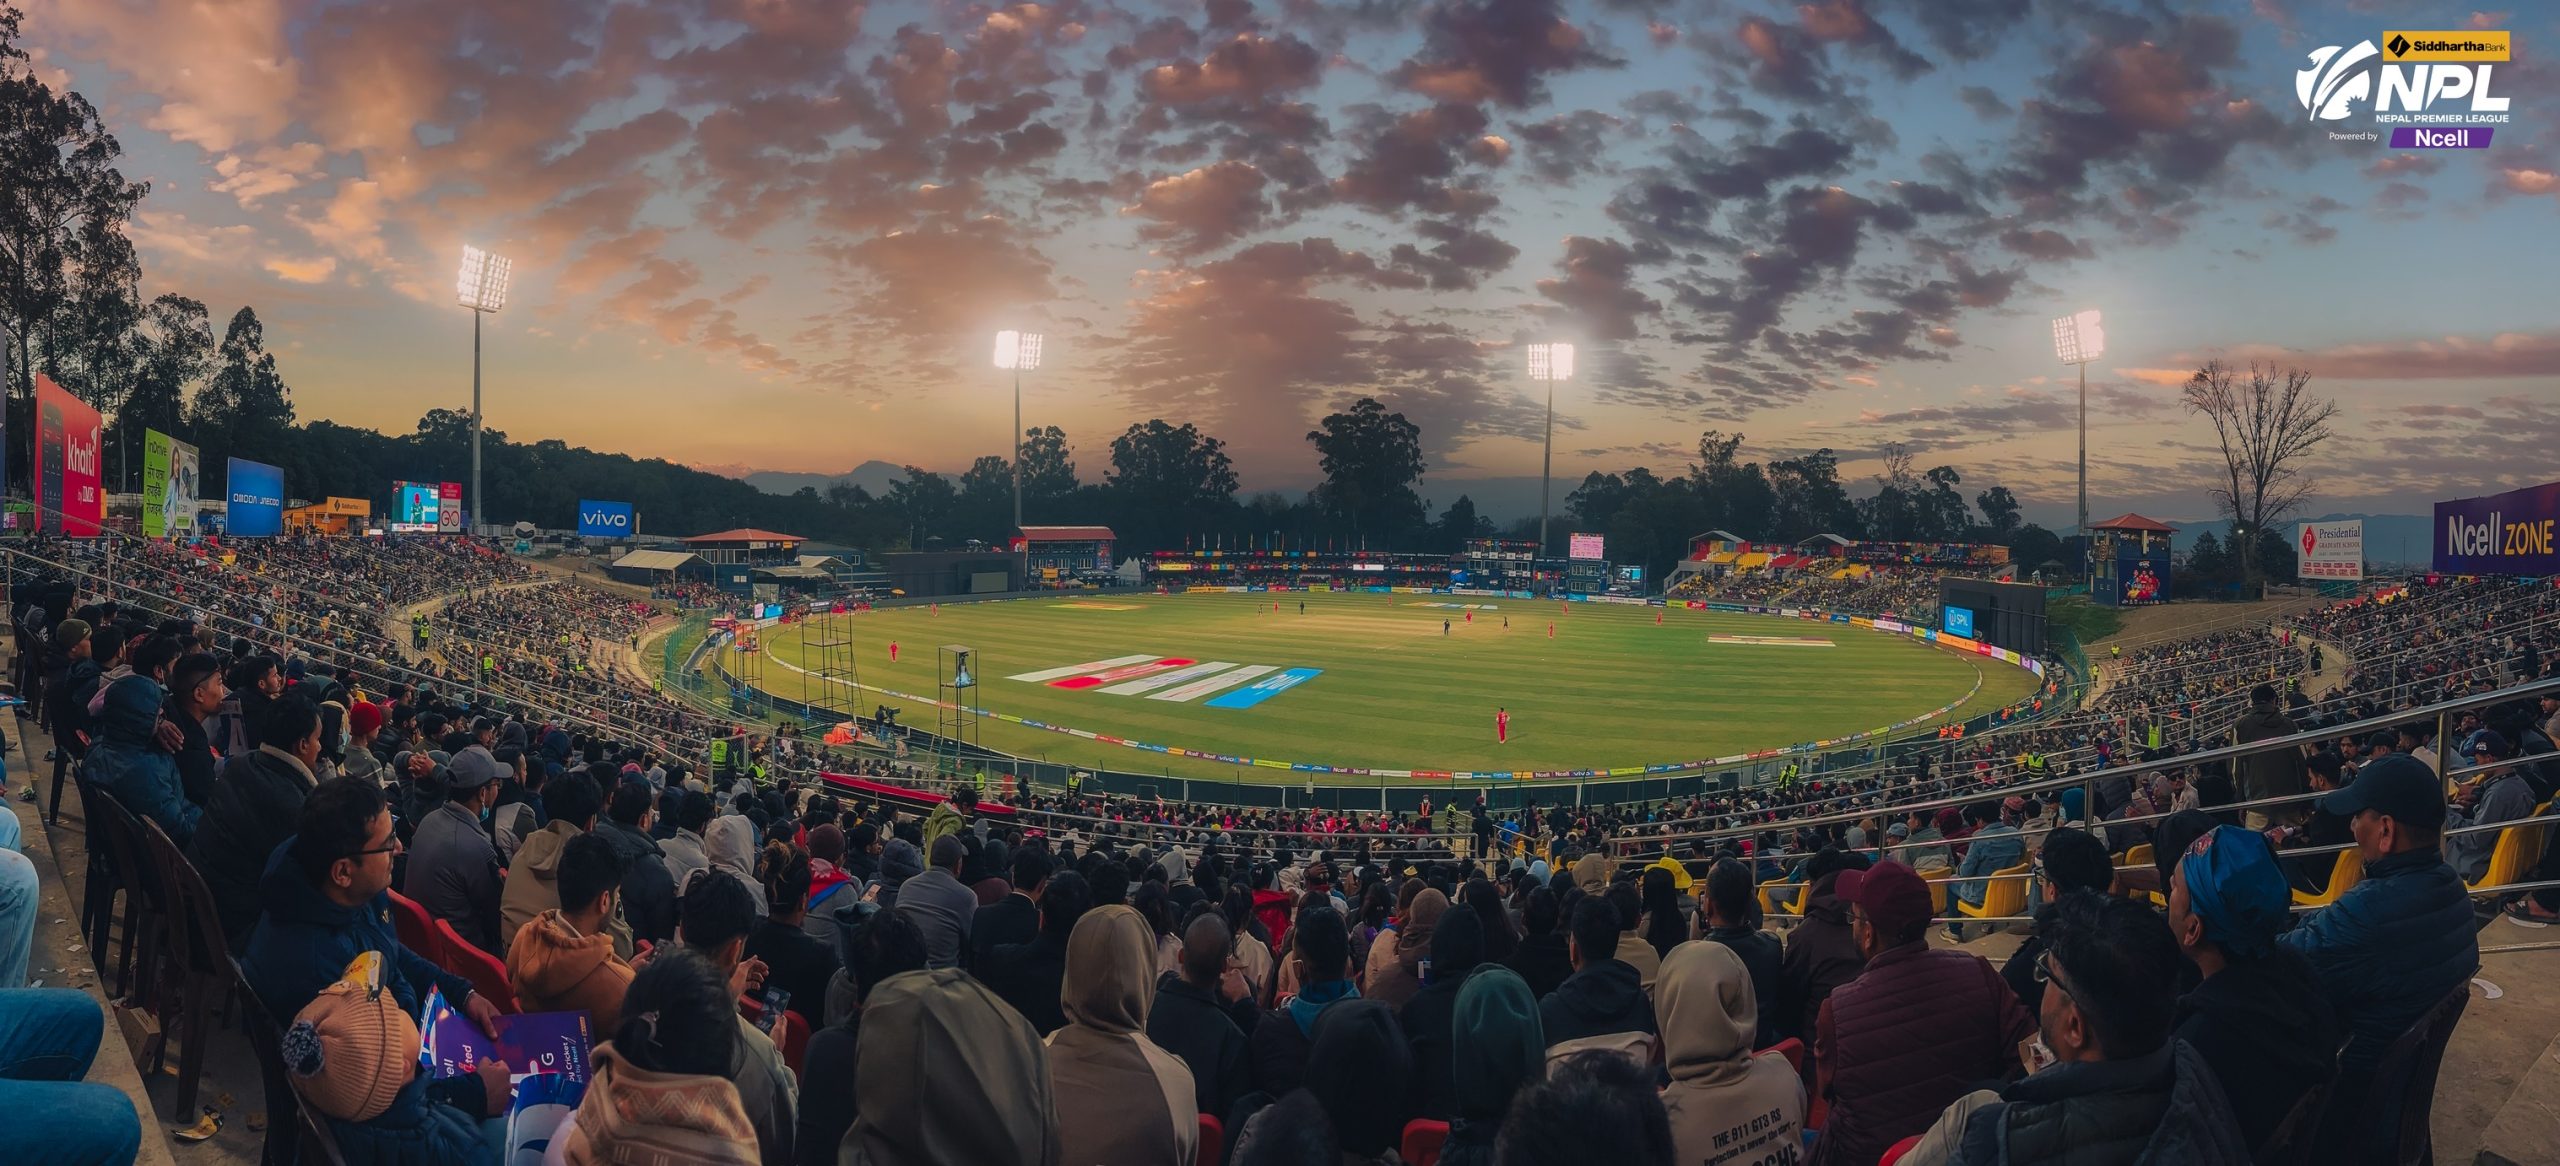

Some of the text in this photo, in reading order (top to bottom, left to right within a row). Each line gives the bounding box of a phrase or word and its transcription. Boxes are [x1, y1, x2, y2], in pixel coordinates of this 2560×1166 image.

[68, 433, 95, 477] khalti
[583, 509, 627, 527] vivo
[2319, 526, 2360, 538] Presidential
[2448, 511, 2555, 556] Ncell ZONE
[541, 1052, 554, 1066] G
[563, 1042, 573, 1070] Cricket
[1712, 1107, 1782, 1149] THE 911 GT3 RS
[1739, 1143, 1746, 1154] is
[1747, 1135, 1767, 1150] never
[1767, 1129, 1778, 1141] the
